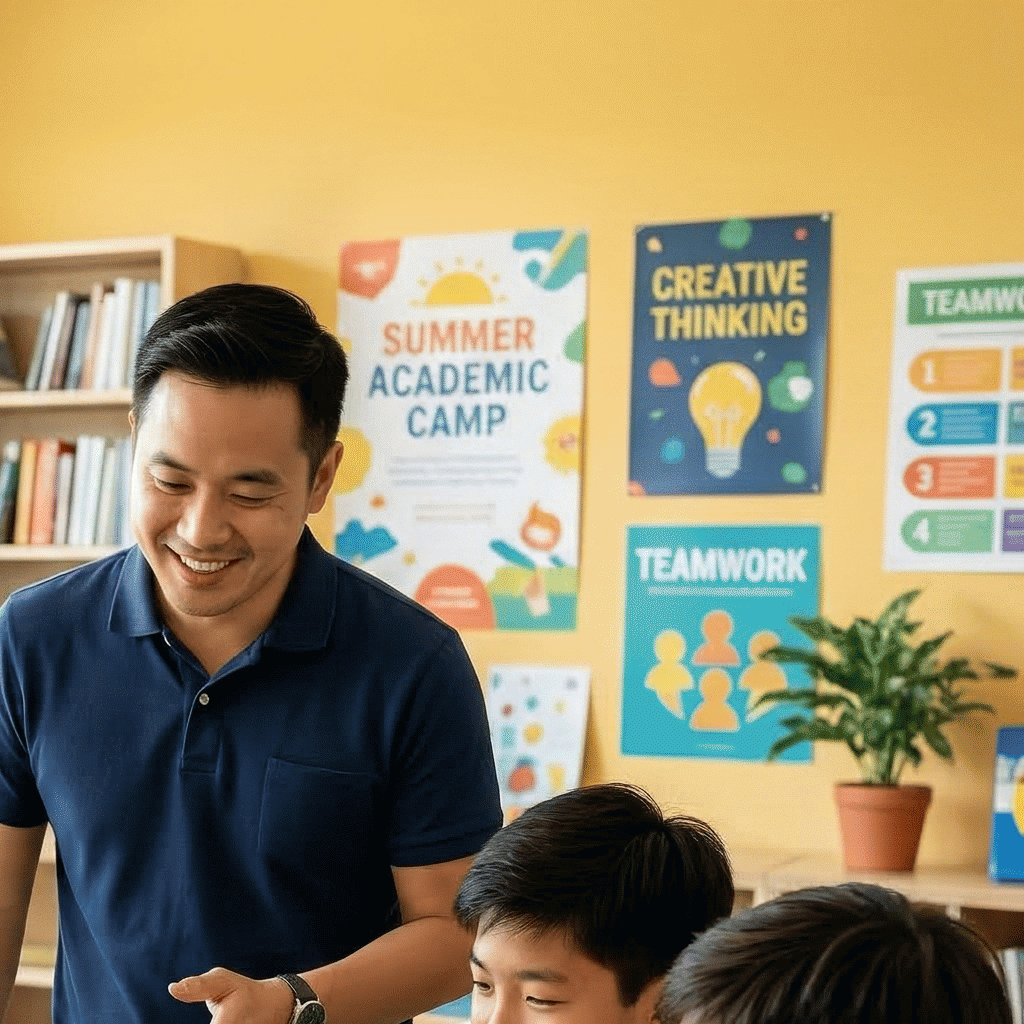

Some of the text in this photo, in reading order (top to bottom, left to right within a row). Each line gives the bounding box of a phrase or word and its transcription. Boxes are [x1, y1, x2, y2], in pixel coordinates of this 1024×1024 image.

[651, 259, 808, 300] CREATIVE
[382, 317, 536, 356] SUMMER
[650, 300, 808, 341] THINKING
[368, 359, 550, 399] ACADEMIC
[922, 359, 935, 385] 1
[407, 403, 507, 439] CAMP
[917, 409, 937, 439] 2
[915, 462, 934, 492] 3
[912, 517, 931, 544] 4
[635, 547, 808, 582] TEAMWORK
